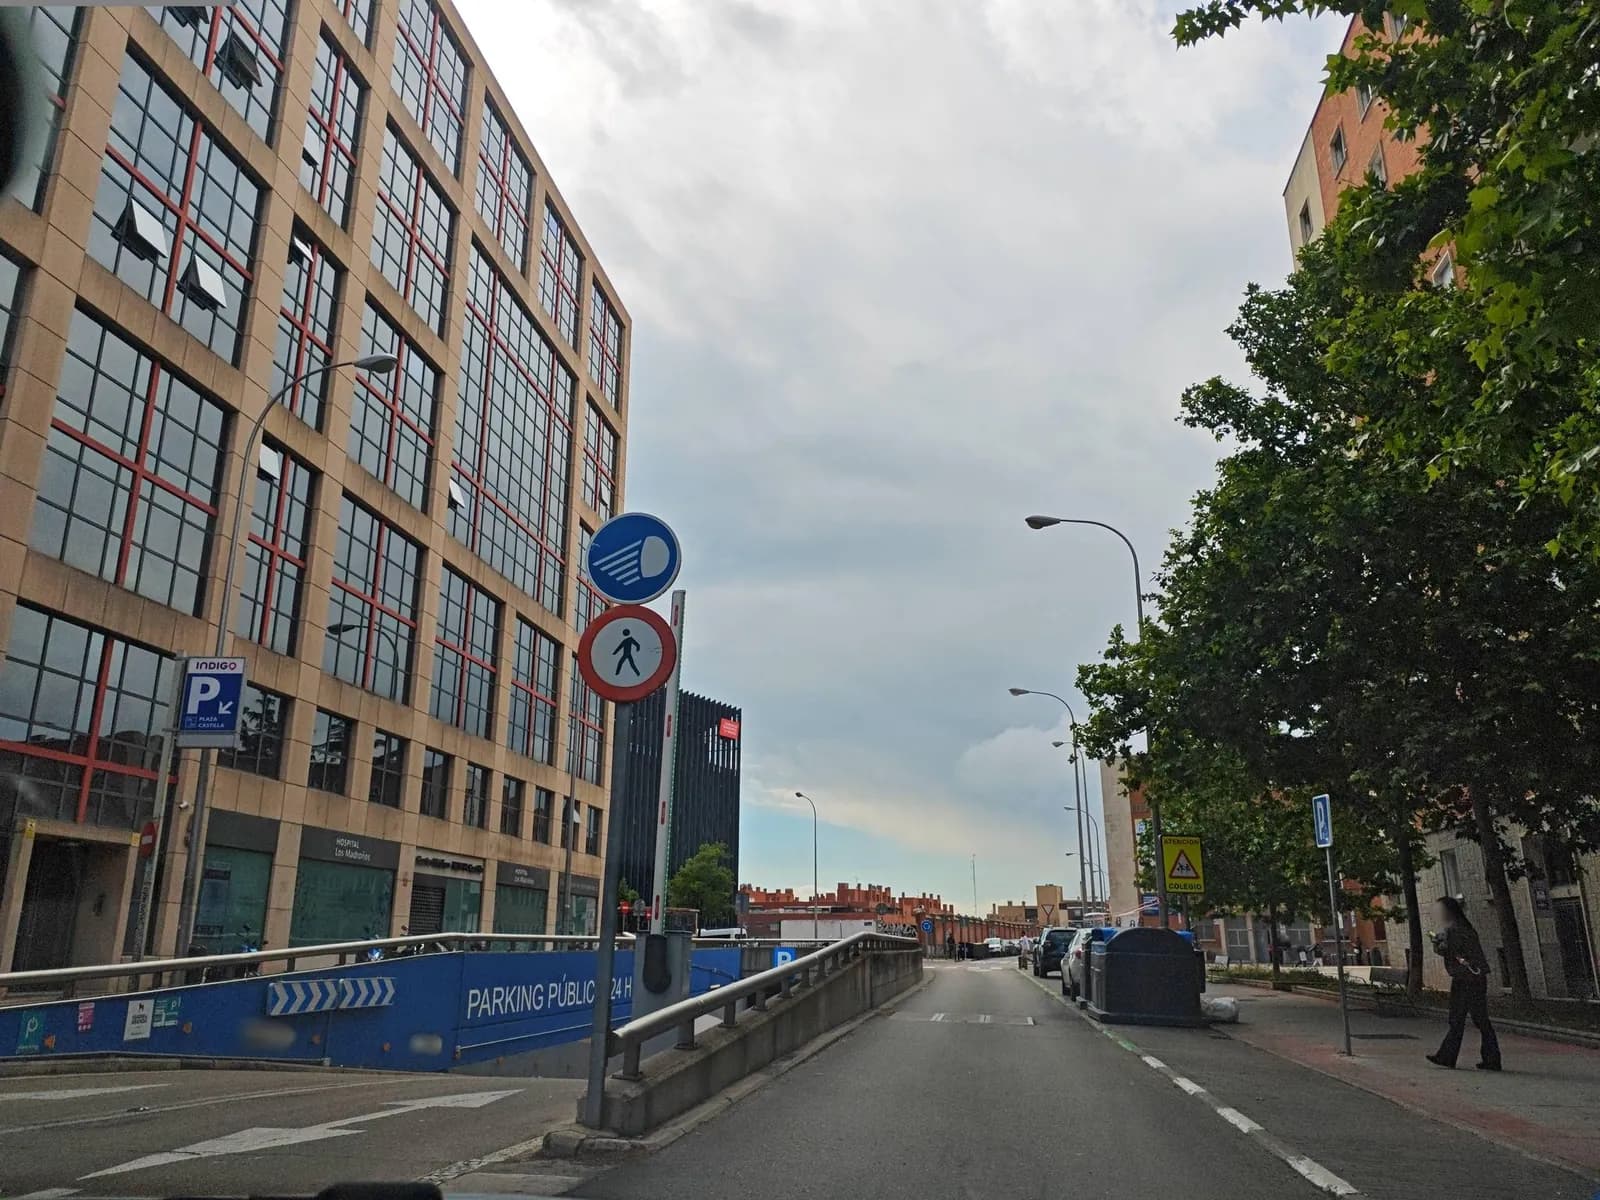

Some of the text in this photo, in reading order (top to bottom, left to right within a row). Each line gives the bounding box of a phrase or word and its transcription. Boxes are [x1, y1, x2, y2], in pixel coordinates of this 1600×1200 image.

[196, 661, 237, 671] INDIGO
[186, 676, 221, 714] P
[336, 837, 360, 849] HOSPITAL
[335, 847, 345, 857] Los
[1168, 882, 1202, 890] COLEGIO
[467, 973, 632, 1020] PARKING PÚBLIC 24 H
